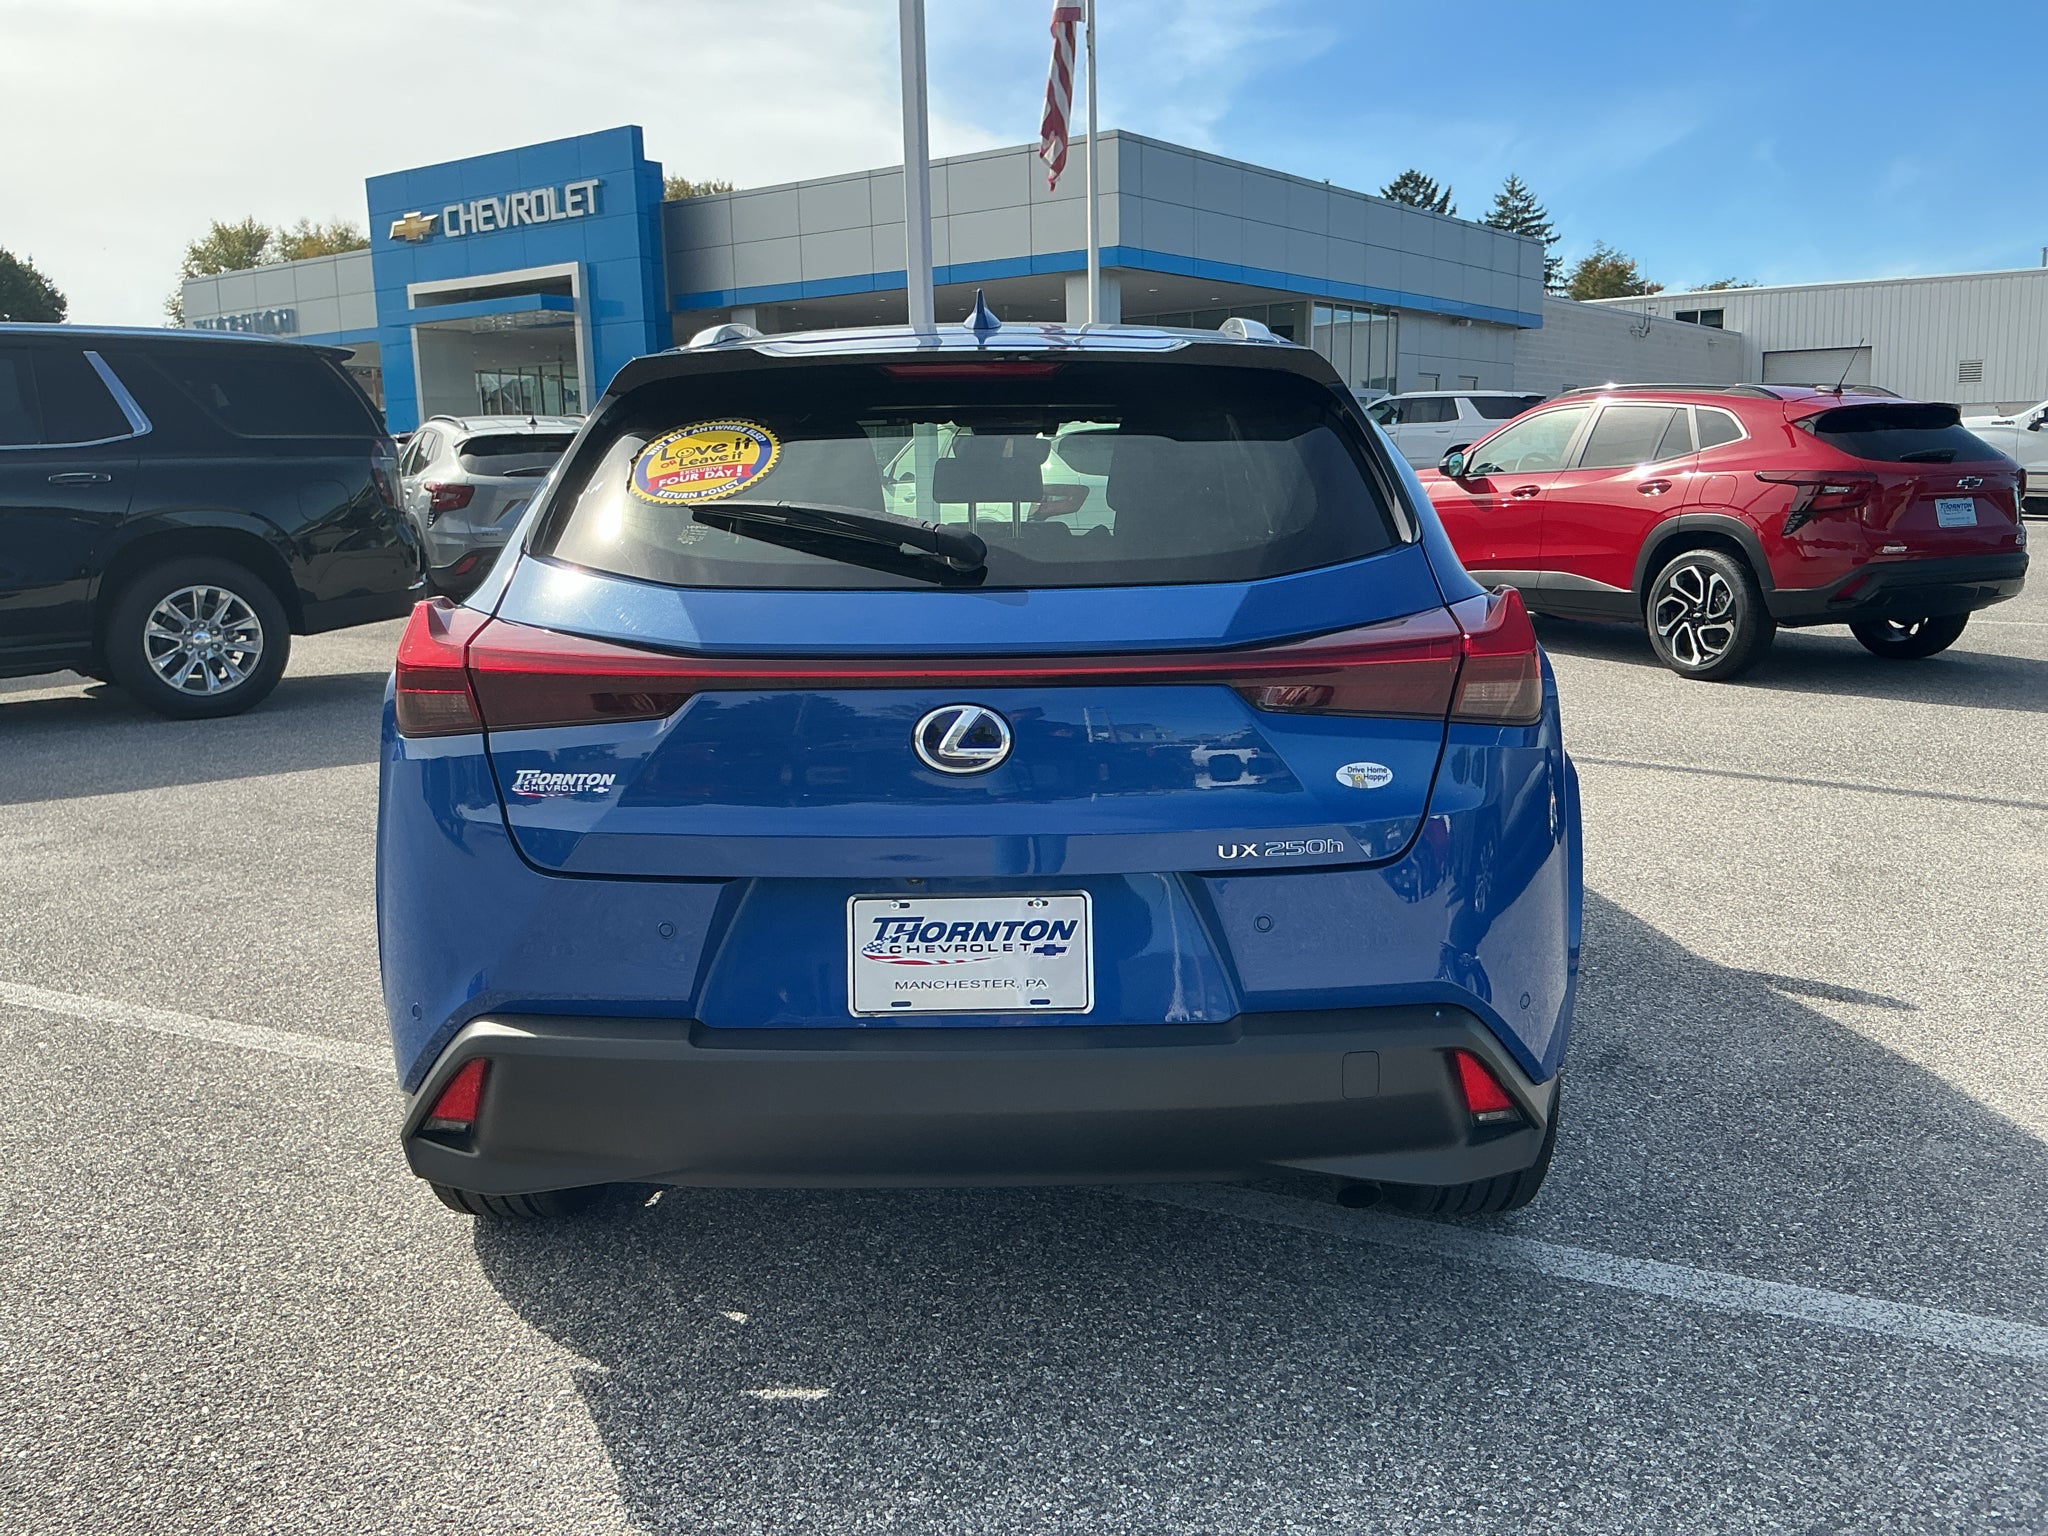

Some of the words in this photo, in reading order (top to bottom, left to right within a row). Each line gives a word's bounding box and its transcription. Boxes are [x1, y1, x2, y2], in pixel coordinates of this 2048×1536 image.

[443, 179, 599, 238] CHEVROLET
[647, 440, 668, 456] WHY
[669, 431, 689, 443] BUY
[691, 424, 746, 436] ANYWHERE
[747, 427, 767, 442] ELSE?
[734, 437, 753, 450] it
[660, 460, 677, 469] OR
[678, 453, 729, 467] Leave
[732, 450, 744, 460] it
[680, 465, 723, 476] EXCLUSIVE
[658, 473, 699, 488] FOUR
[656, 488, 698, 499] RETURN
[700, 480, 740, 497] POLICY
[516, 769, 616, 785] THORNTON
[1364, 773, 1388, 782] Happy!
[1217, 843, 1260, 859] UX
[1264, 838, 1344, 857] 250h
[872, 916, 1079, 943] THORNTON
[889, 943, 1031, 954] CHEVROLET
[895, 979, 1020, 990] MANCHESTER,
[1026, 978, 1047, 988] PA
